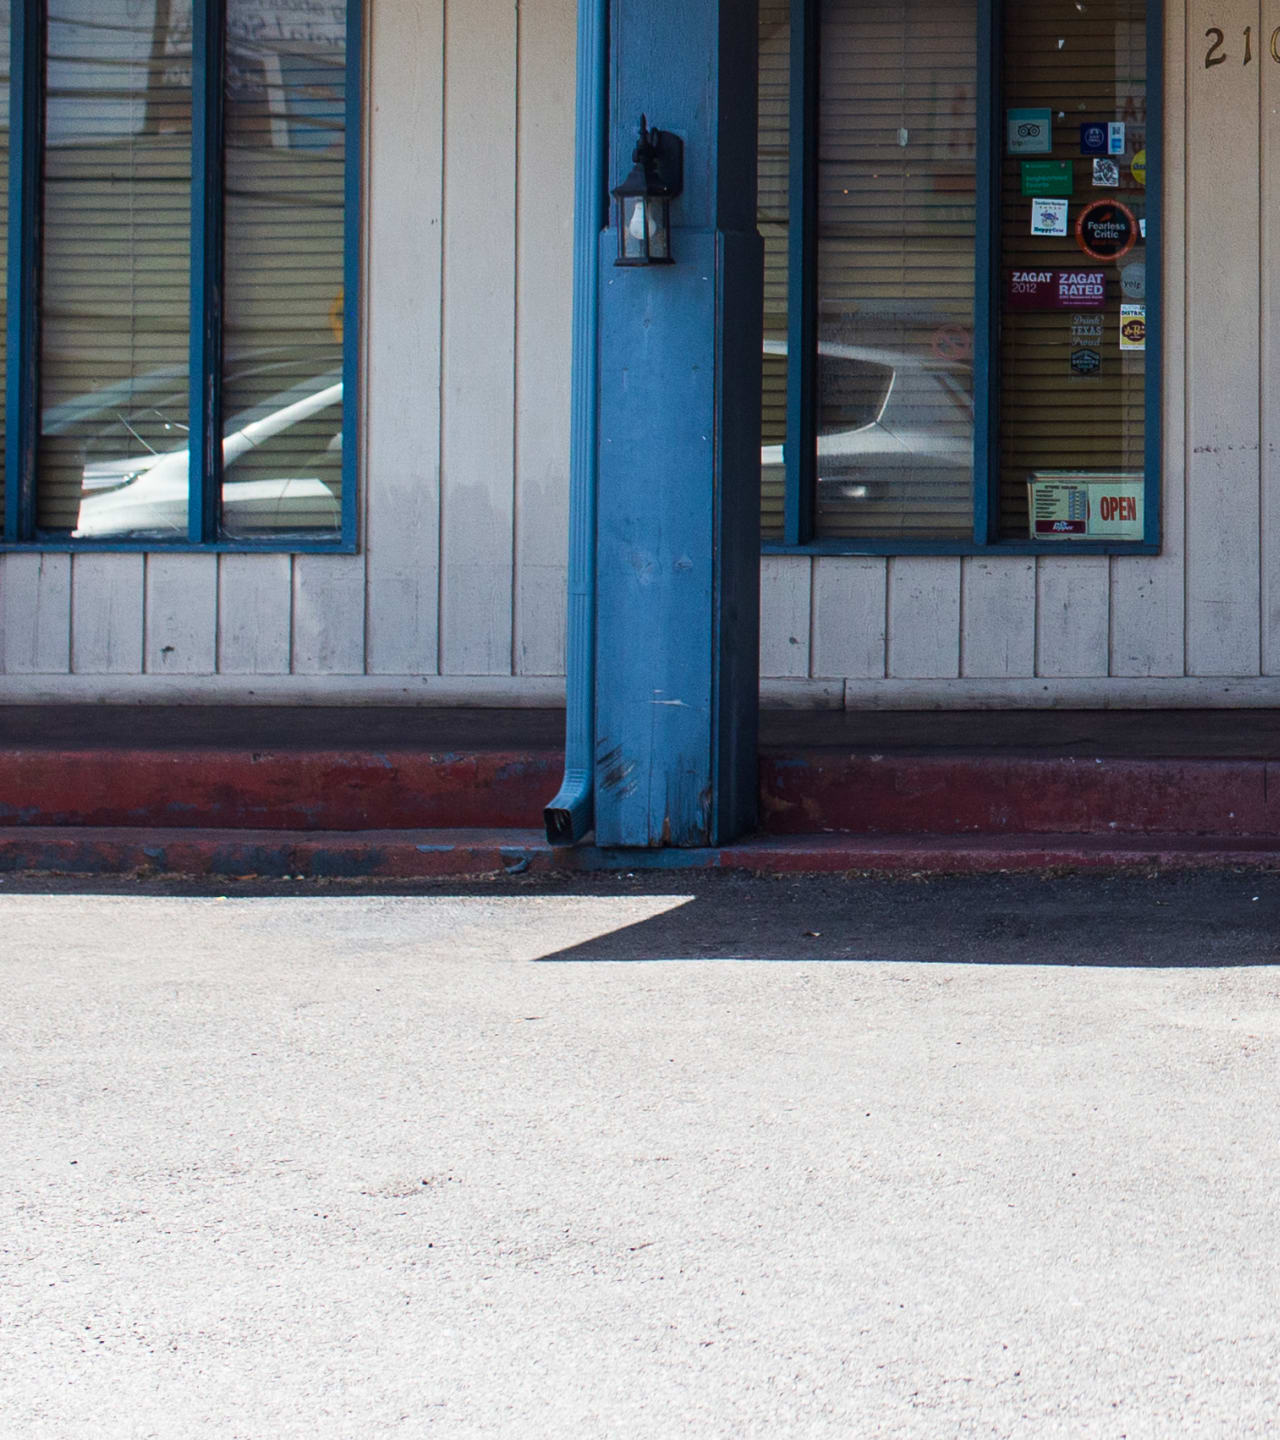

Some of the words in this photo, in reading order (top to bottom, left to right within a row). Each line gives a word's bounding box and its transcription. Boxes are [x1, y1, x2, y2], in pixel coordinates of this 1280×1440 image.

[1087, 221, 1126, 231] Fearless
[1093, 230, 1119, 239] Critic
[1012, 272, 1053, 283] ZAGAT
[1058, 273, 1104, 284] ZAGAT
[1011, 283, 1038, 294] 2012
[1058, 284, 1104, 296] RATED
[1071, 326, 1103, 336] TEXAS
[1100, 496, 1136, 521] OPEN
